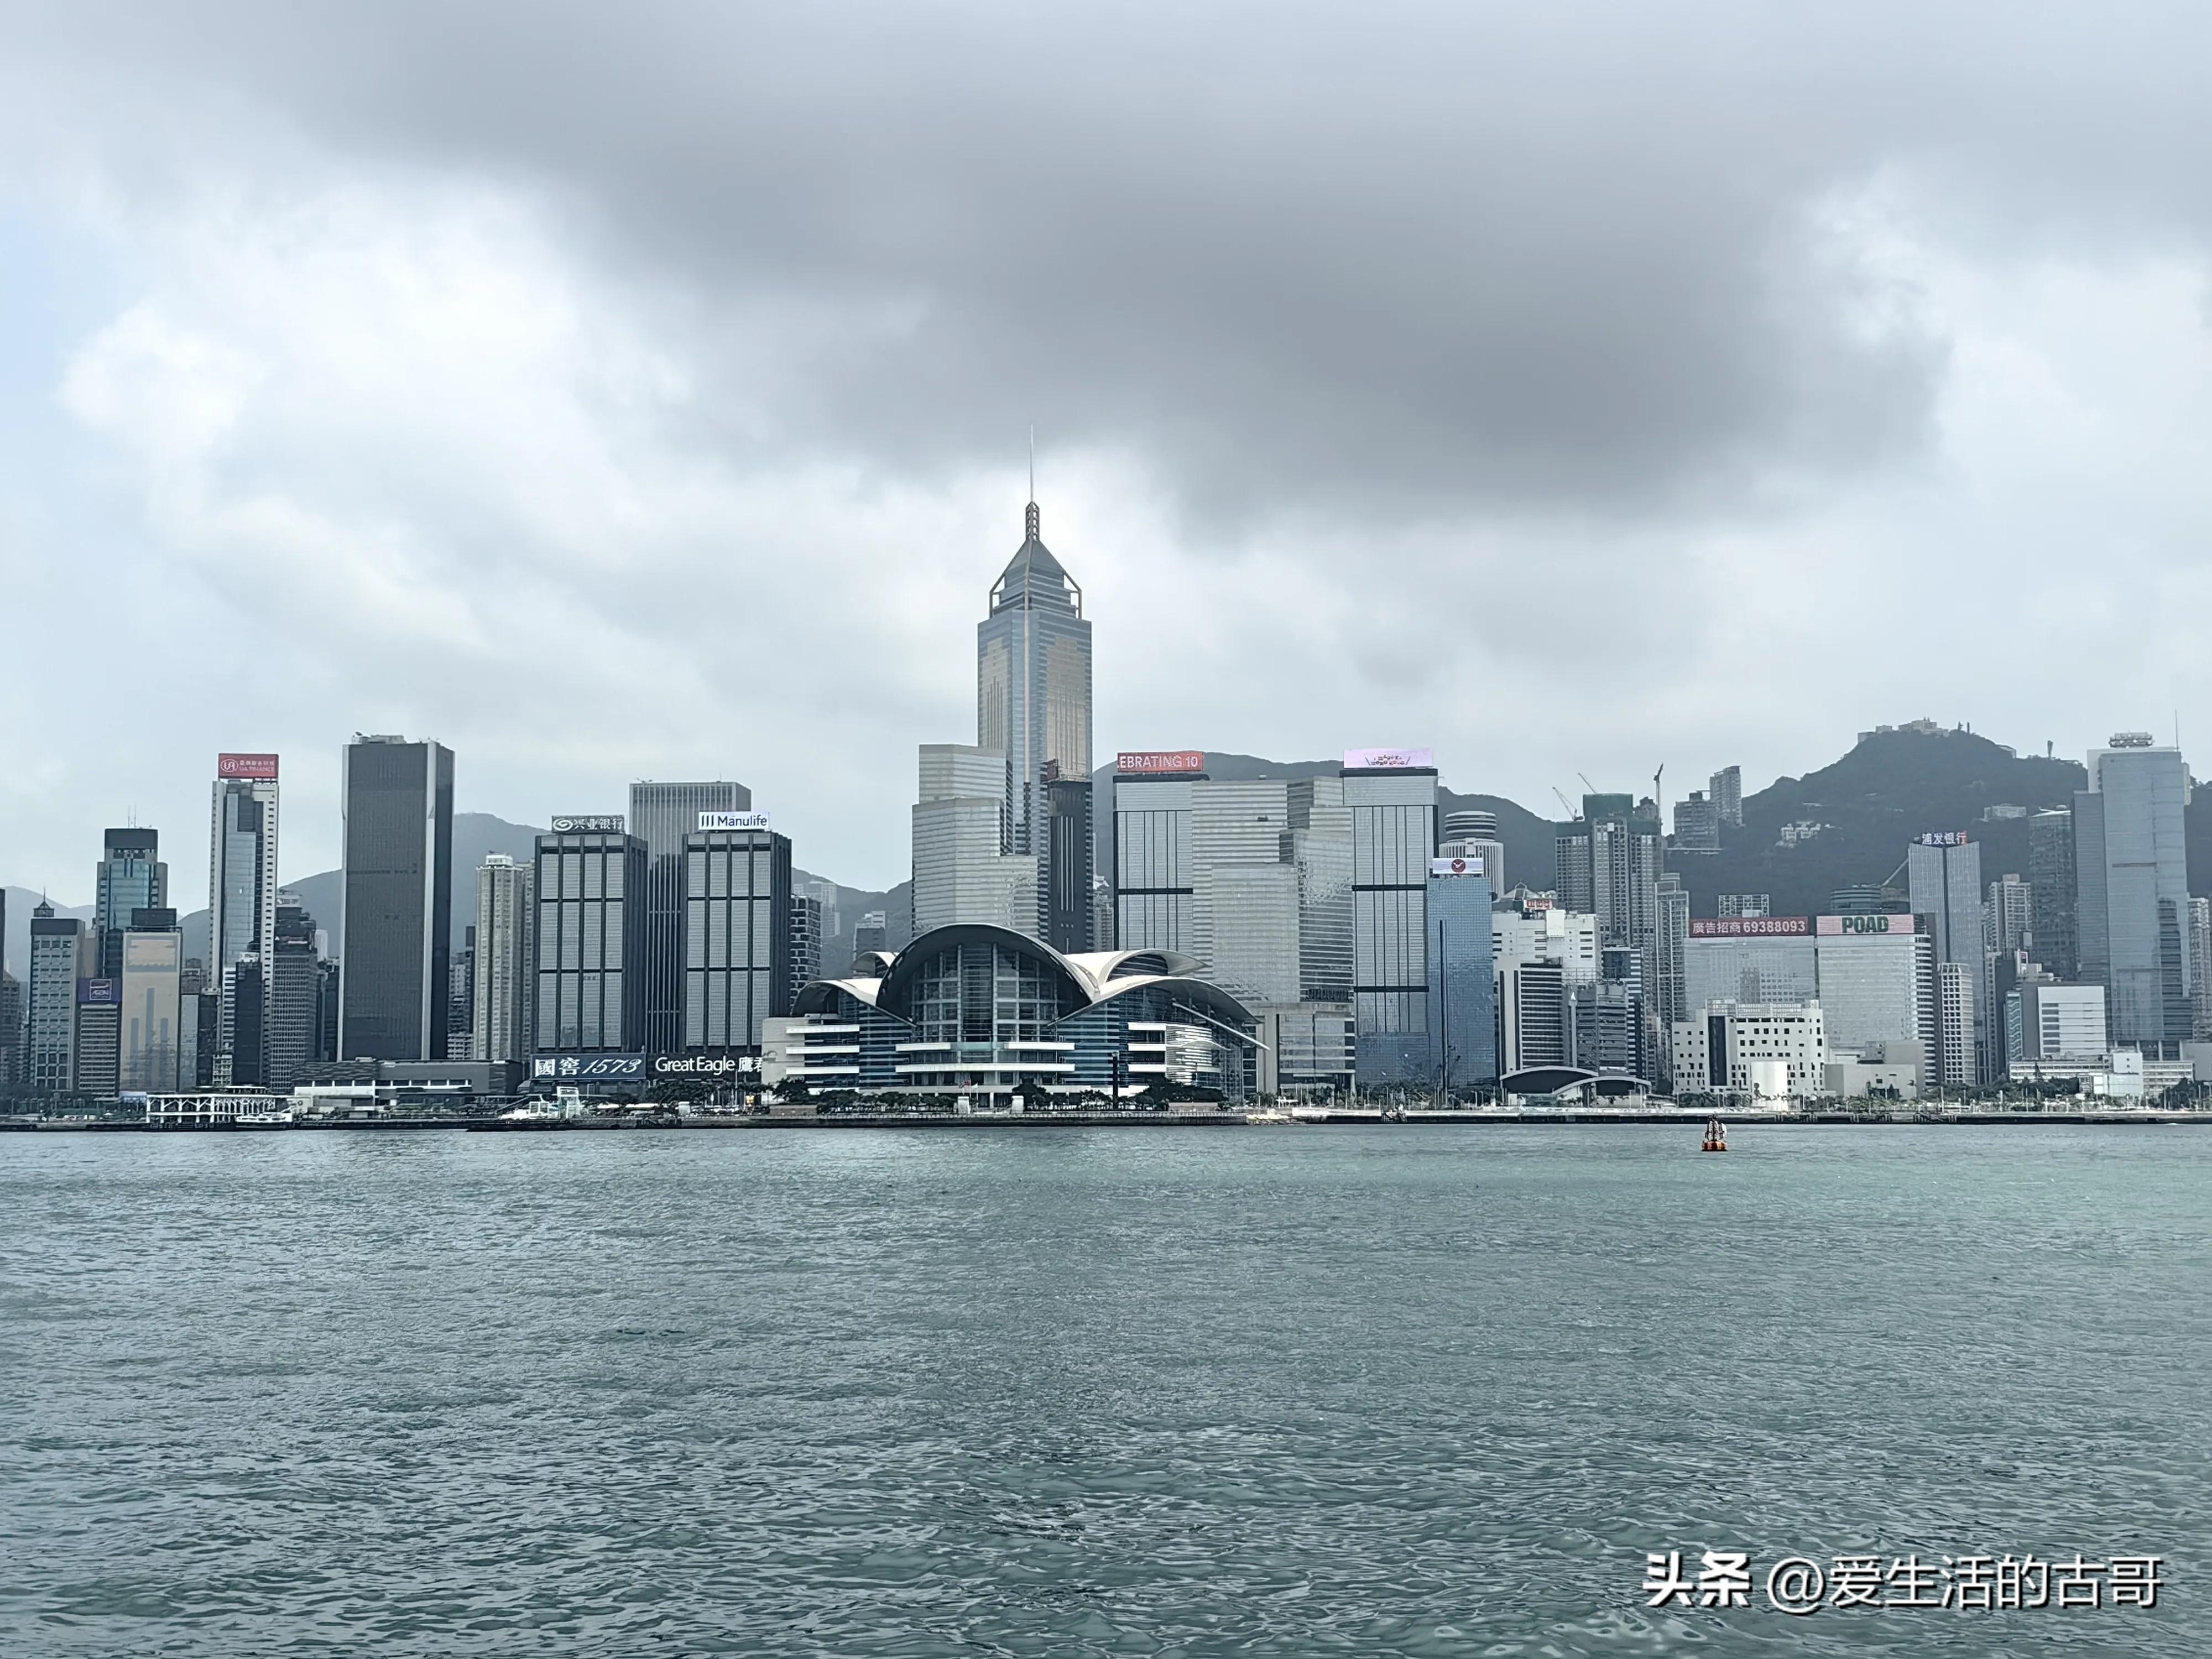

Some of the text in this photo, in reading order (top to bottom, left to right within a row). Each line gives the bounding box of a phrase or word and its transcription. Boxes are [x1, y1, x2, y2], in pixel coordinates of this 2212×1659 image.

[1117, 755, 1182, 769] EBRATING
[573, 818, 623, 830] 兴业银行
[718, 815, 767, 826] Manulife
[1922, 831, 1967, 845] 浦发银行
[1693, 920, 1806, 934] 廣告招商 69388093
[1842, 916, 1889, 933] POAD
[655, 1057, 695, 1072] Great
[696, 1055, 735, 1075] Eagle
